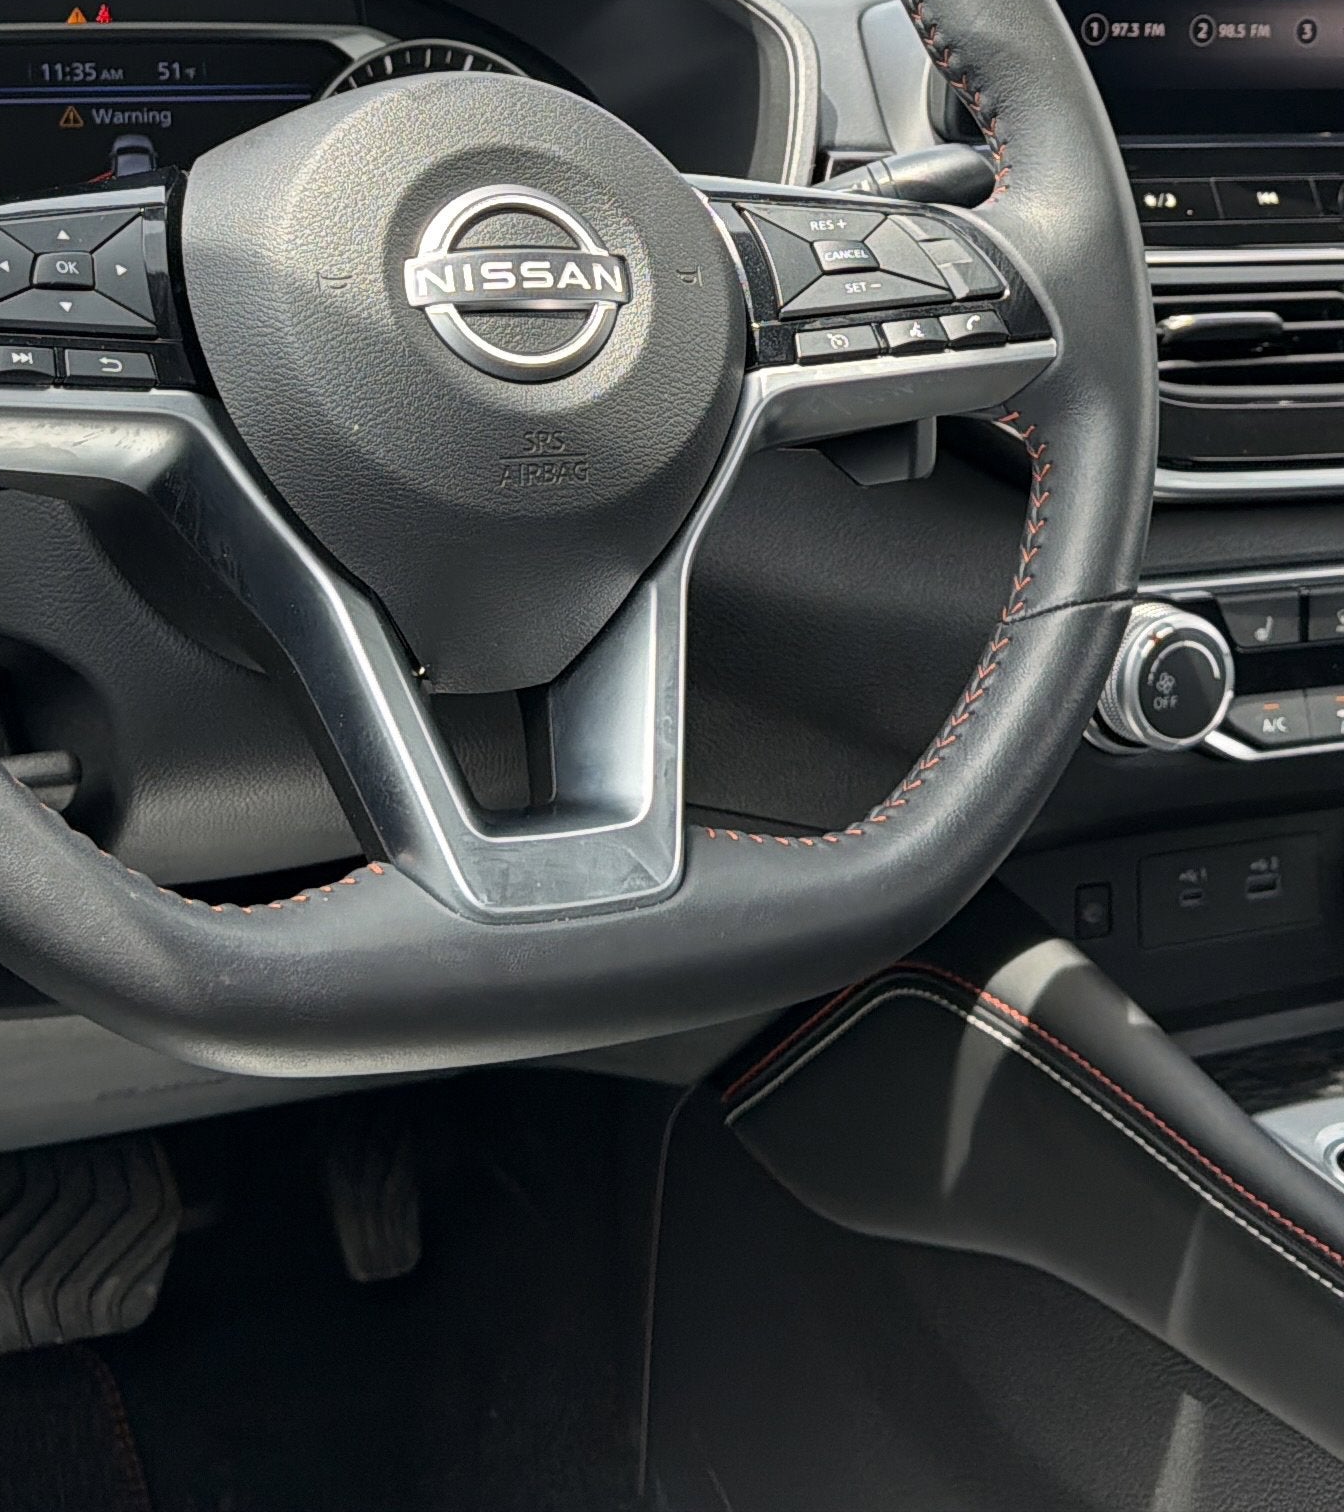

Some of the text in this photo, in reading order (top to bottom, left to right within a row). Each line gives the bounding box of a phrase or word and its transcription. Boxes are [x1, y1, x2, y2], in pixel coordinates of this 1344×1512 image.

[1111, 23, 1140, 37] 97.3
[1144, 23, 1166, 38] FM
[1218, 23, 1247, 39] 98.5
[1250, 24, 1271, 39] FM
[41, 62, 97, 82] 11:35
[100, 70, 124, 80] AM
[92, 108, 172, 128] Warning
[810, 220, 834, 231] RES
[824, 249, 869, 262] CANCEL
[56, 261, 79, 275] OK
[416, 261, 623, 296] NISSAN
[845, 282, 867, 294] SET
[523, 431, 566, 454] SRS
[497, 460, 589, 488] AIRBAG
[1153, 695, 1179, 710] OFF
[1263, 717, 1288, 733] A/C
